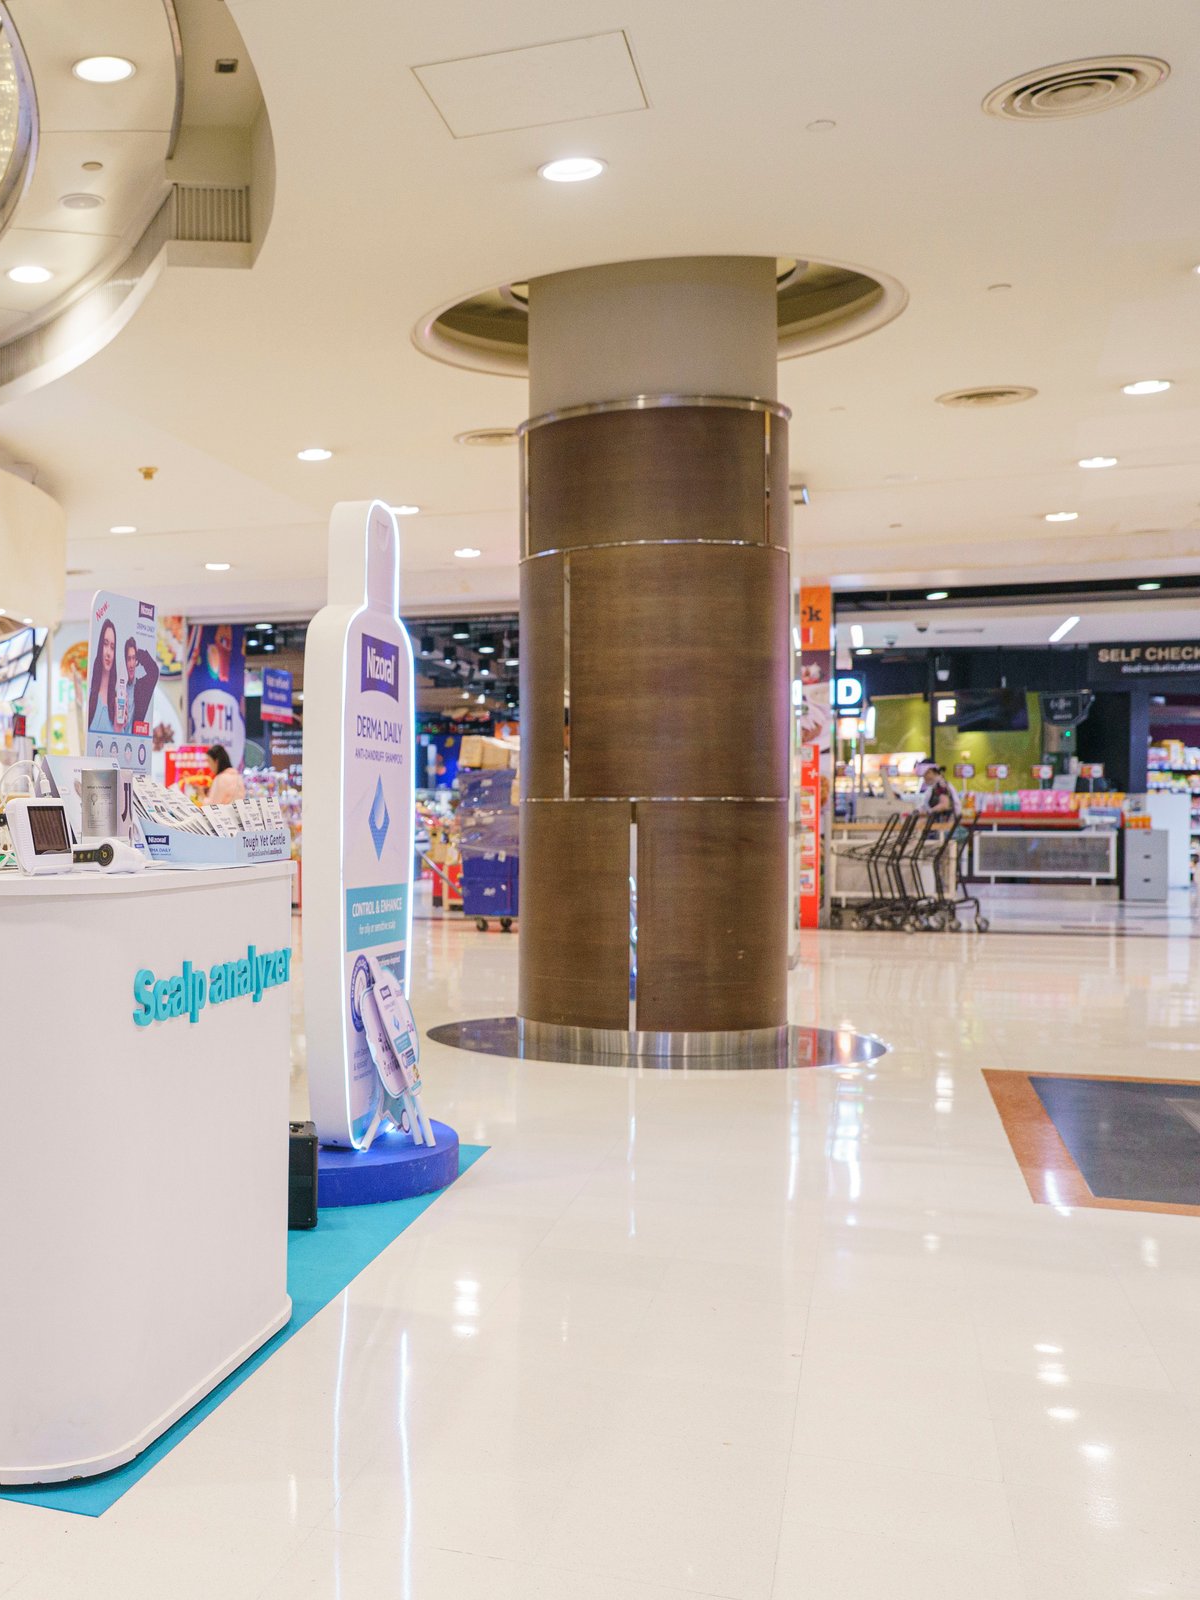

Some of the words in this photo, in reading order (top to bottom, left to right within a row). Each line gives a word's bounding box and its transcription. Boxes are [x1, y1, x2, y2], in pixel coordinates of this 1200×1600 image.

[1097, 648, 1141, 663] SELF
[837, 678, 862, 705] D
[937, 699, 956, 722] F
[356, 714, 382, 740] DERMA
[383, 720, 402, 744] DAILY
[355, 747, 385, 762] ANTI-DANDRUFF
[384, 752, 402, 765] SHAMPOO
[242, 834, 259, 851] Tough
[260, 835, 269, 847] Yet
[270, 833, 286, 846] Gentle
[352, 901, 375, 918] CONTROL
[380, 897, 402, 913] ENHANCE
[133, 960, 207, 1026] Scalp
[208, 945, 292, 1004] analyzer
